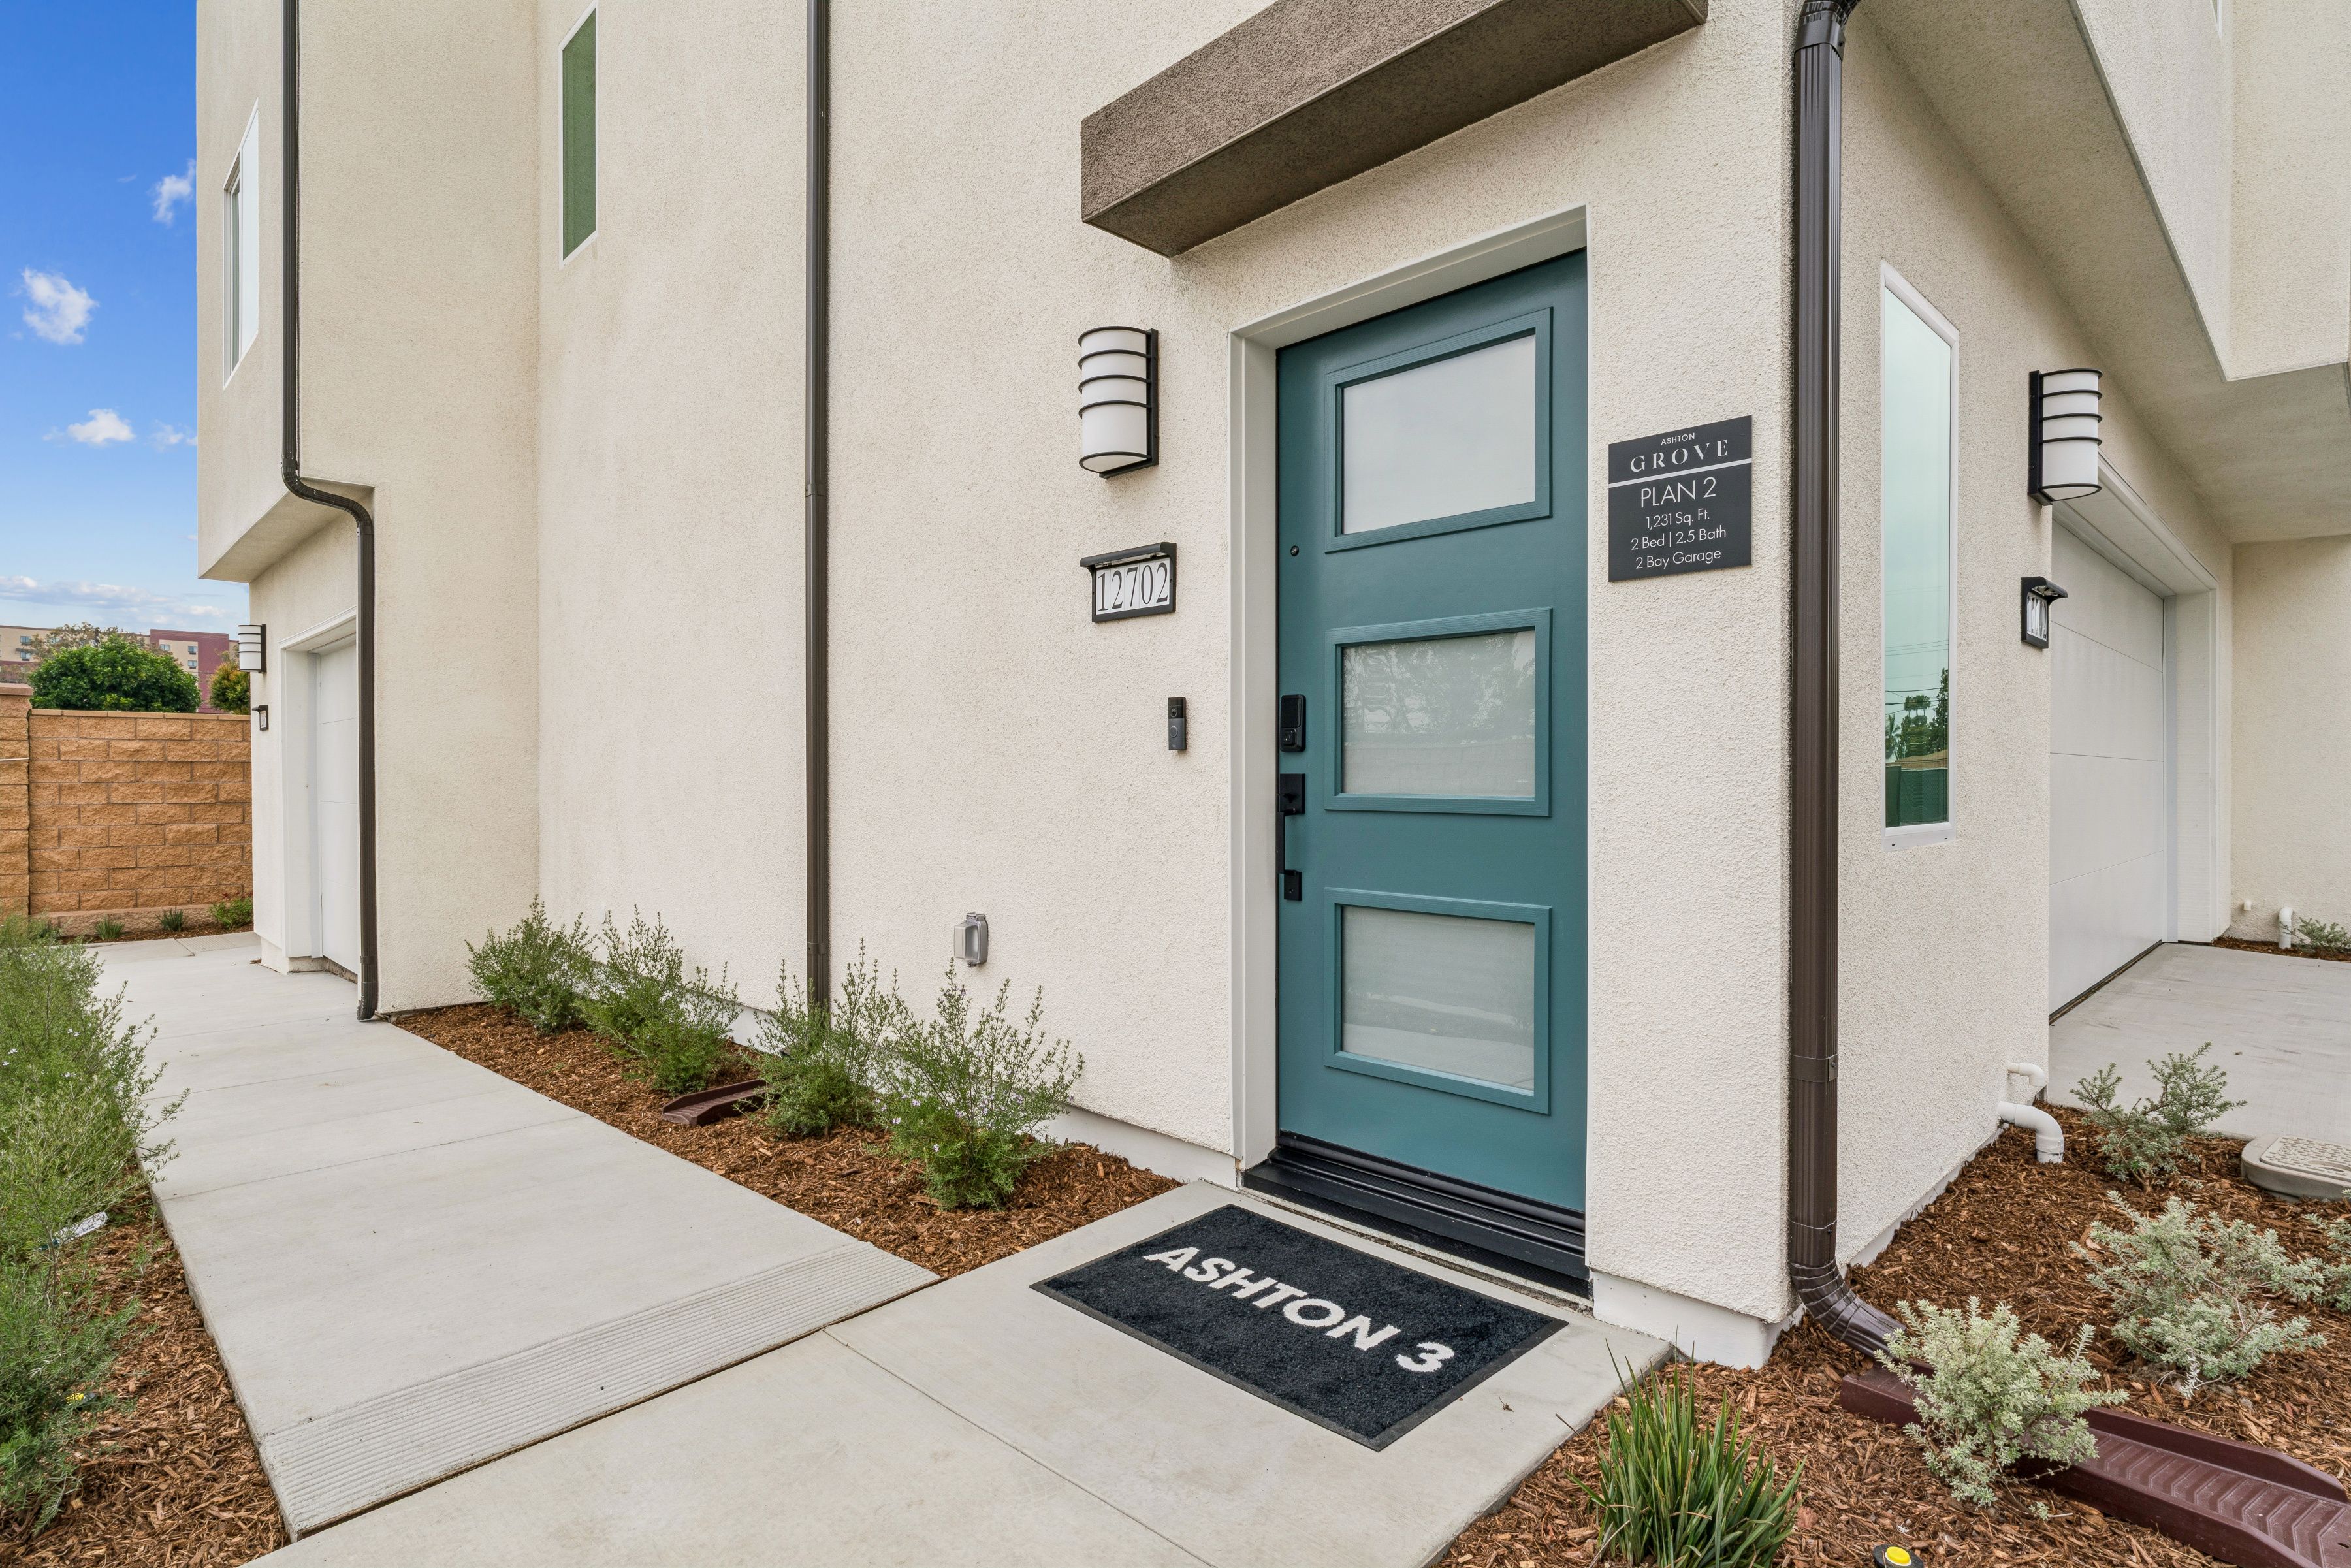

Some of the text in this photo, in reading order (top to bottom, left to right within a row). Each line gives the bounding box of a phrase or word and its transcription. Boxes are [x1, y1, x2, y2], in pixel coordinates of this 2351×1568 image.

[1661, 432, 1695, 445] ASHTON
[1630, 439, 1728, 472] GROVE
[1640, 477, 1716, 508] PLAN 2
[1646, 508, 1710, 530] 1,231 Sq. Ft.
[1631, 538, 1639, 551] 2
[1642, 533, 1665, 549] Bed
[1676, 530, 1695, 544] 2.5
[1699, 524, 1727, 541] Bath
[1635, 550, 1721, 569] 2 Bay Garage
[1097, 562, 1169, 612] 12702
[1143, 1246, 1456, 1373] ASHTON 3
